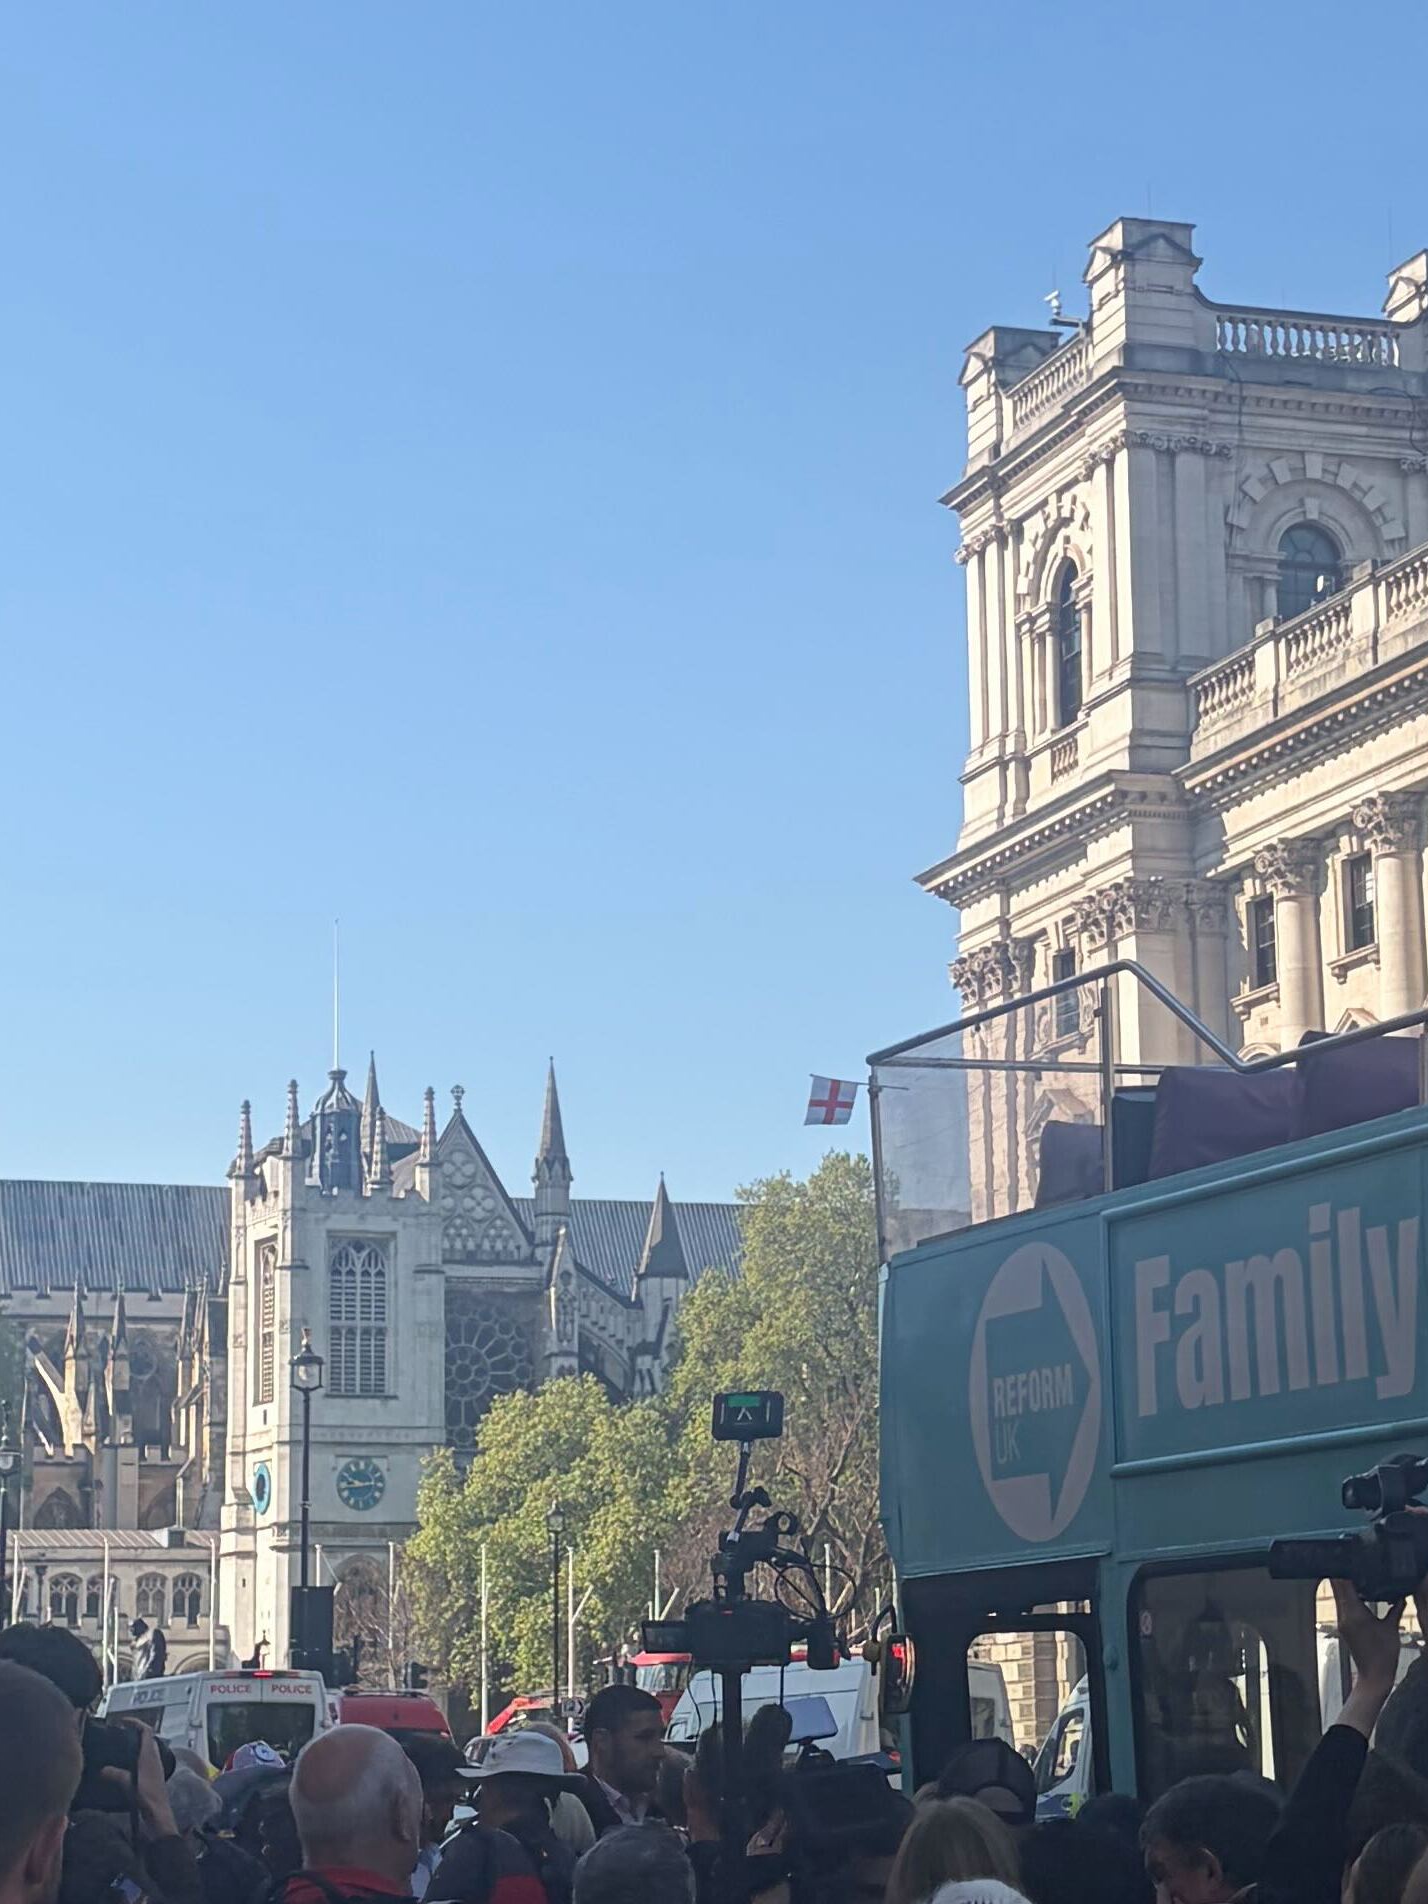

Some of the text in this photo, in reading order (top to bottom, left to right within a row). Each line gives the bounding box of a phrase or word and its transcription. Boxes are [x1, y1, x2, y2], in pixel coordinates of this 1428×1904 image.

[1134, 1201, 1420, 1417] Family
[992, 1363, 1074, 1419] REFORM
[994, 1419, 1022, 1465] UK
[209, 1684, 252, 1694] POLICE
[271, 1684, 313, 1695] POLICE
